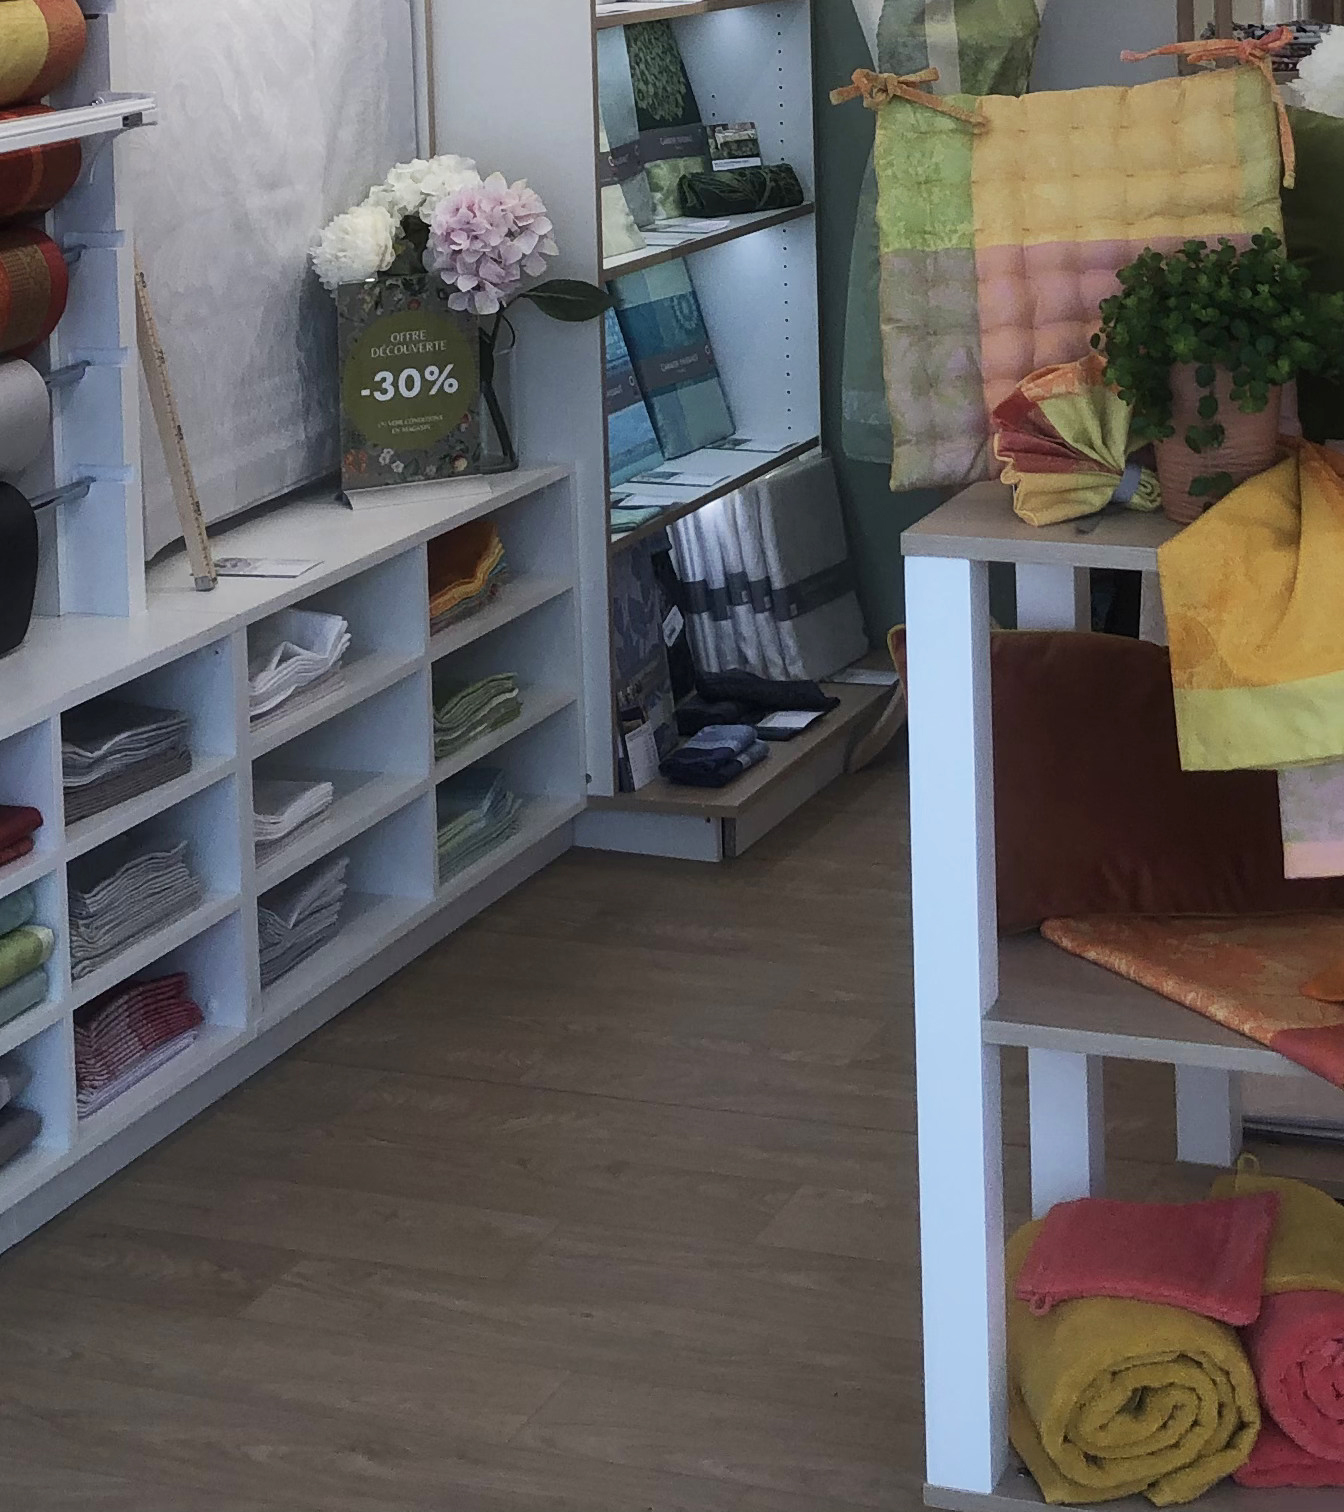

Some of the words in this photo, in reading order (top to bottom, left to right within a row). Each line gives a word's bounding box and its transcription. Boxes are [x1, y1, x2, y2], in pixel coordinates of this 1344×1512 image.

[390, 329, 427, 343] OFFRE
[370, 340, 447, 358] DÉCOUVERTE
[360, 363, 459, 402] -30%
